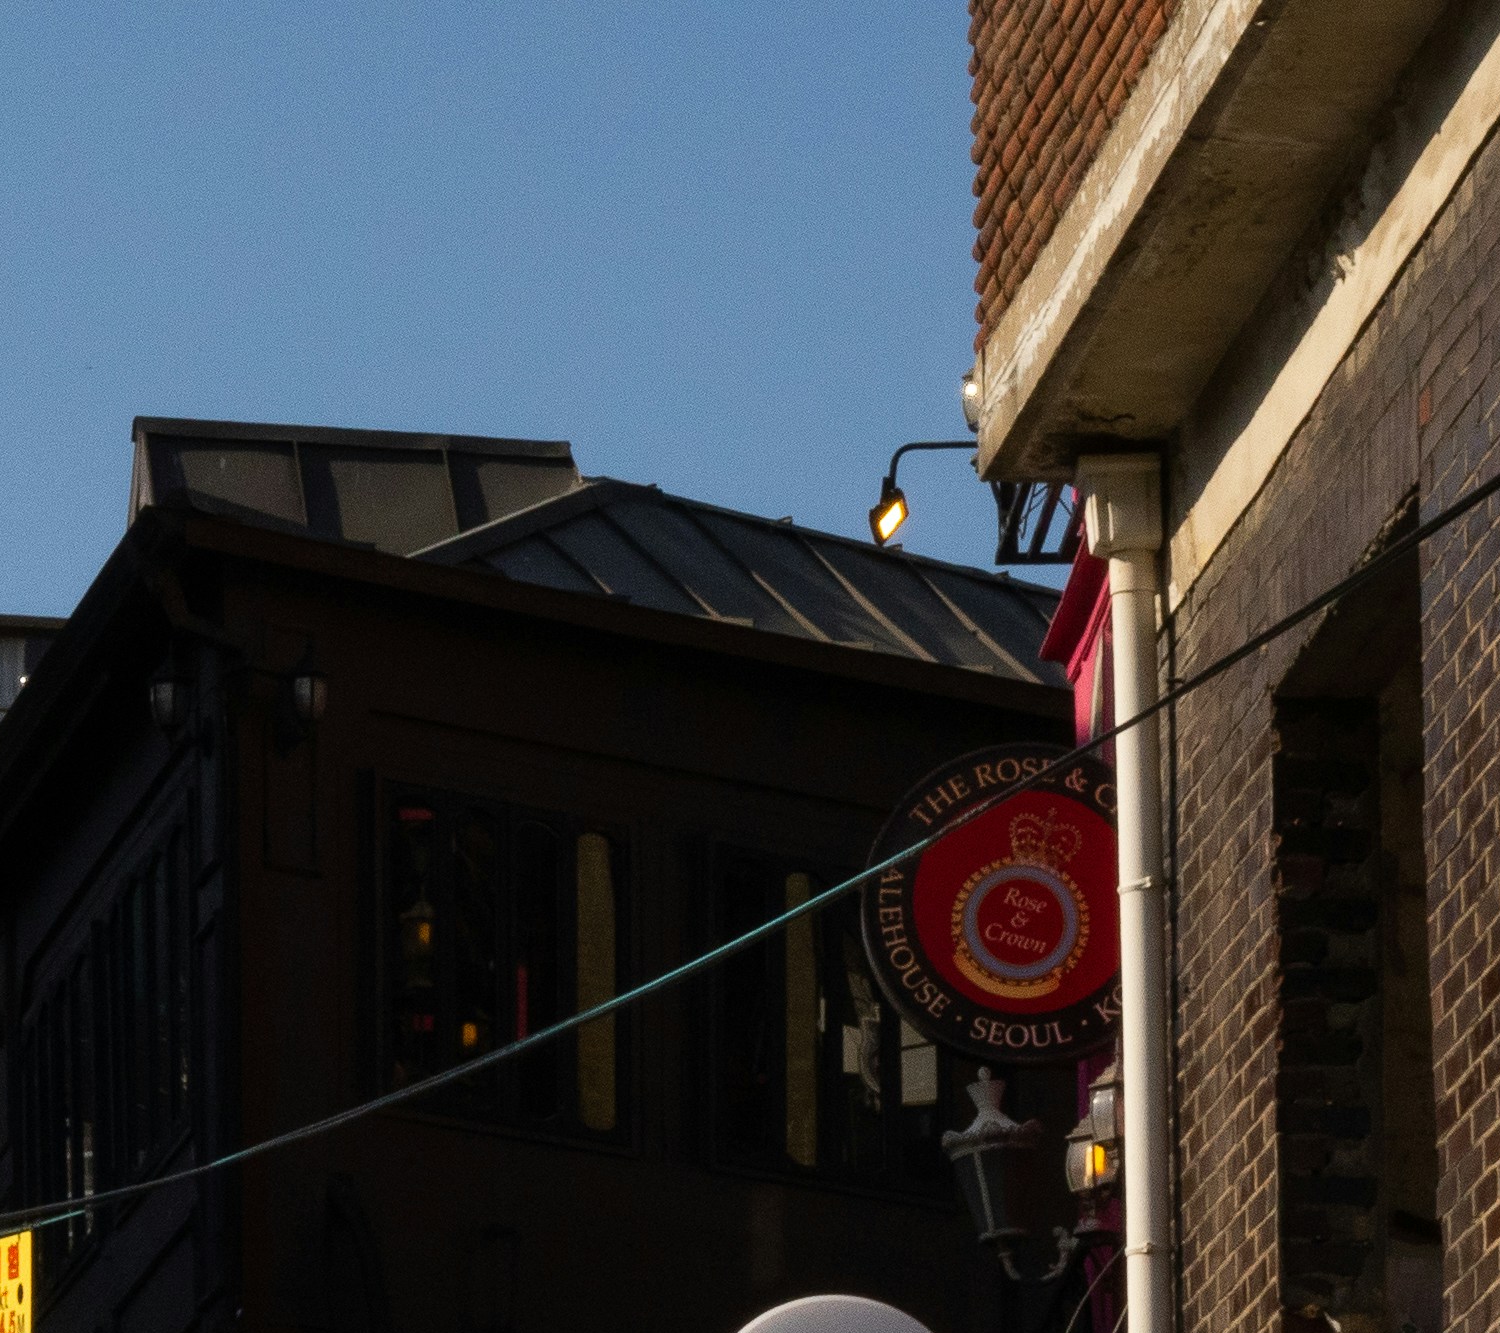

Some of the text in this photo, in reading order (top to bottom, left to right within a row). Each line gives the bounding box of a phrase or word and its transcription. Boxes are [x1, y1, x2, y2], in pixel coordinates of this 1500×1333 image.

[908, 772, 971, 828] THE
[1064, 766, 1088, 793] &
[1003, 886, 1048, 915] Rose
[1011, 910, 1030, 929] &
[878, 866, 952, 1019] ALEHOUSE
[984, 922, 1047, 955] Crown
[969, 1016, 1073, 1050] SEOUL
